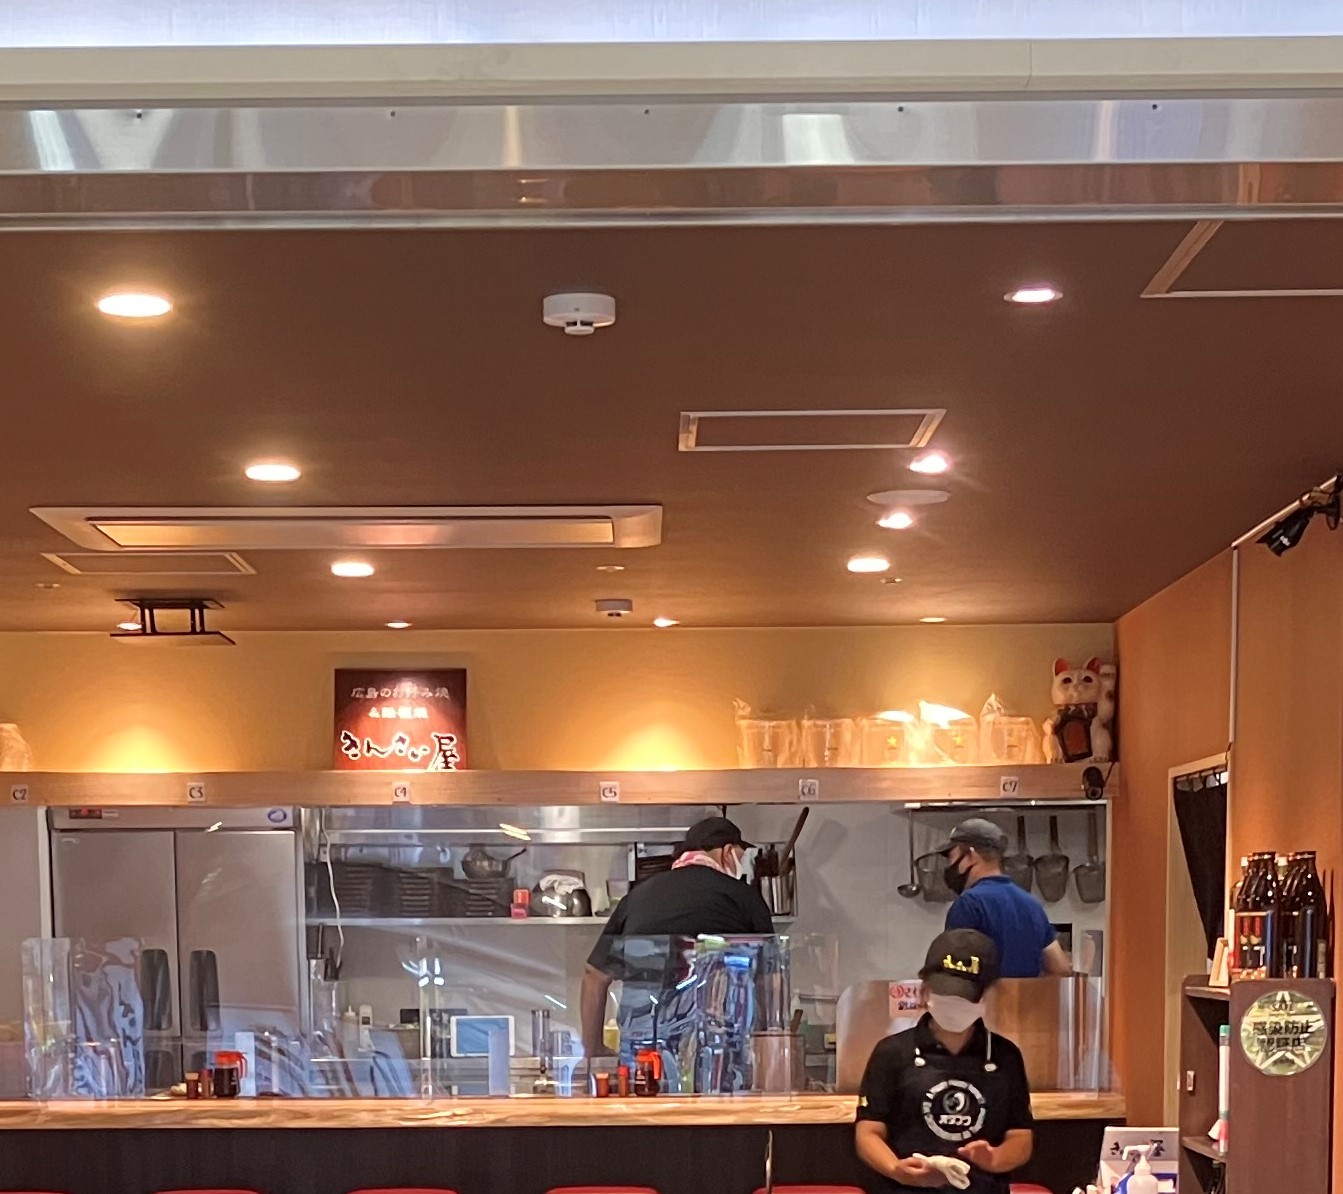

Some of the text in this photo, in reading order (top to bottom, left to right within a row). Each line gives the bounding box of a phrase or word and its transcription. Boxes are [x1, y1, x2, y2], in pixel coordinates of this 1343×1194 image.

[189, 786, 204, 799] C3
[601, 786, 618, 799] C5
[801, 783, 817, 796] C6
[1002, 781, 1018, 793] C7
[13, 788, 28, 802] C2
